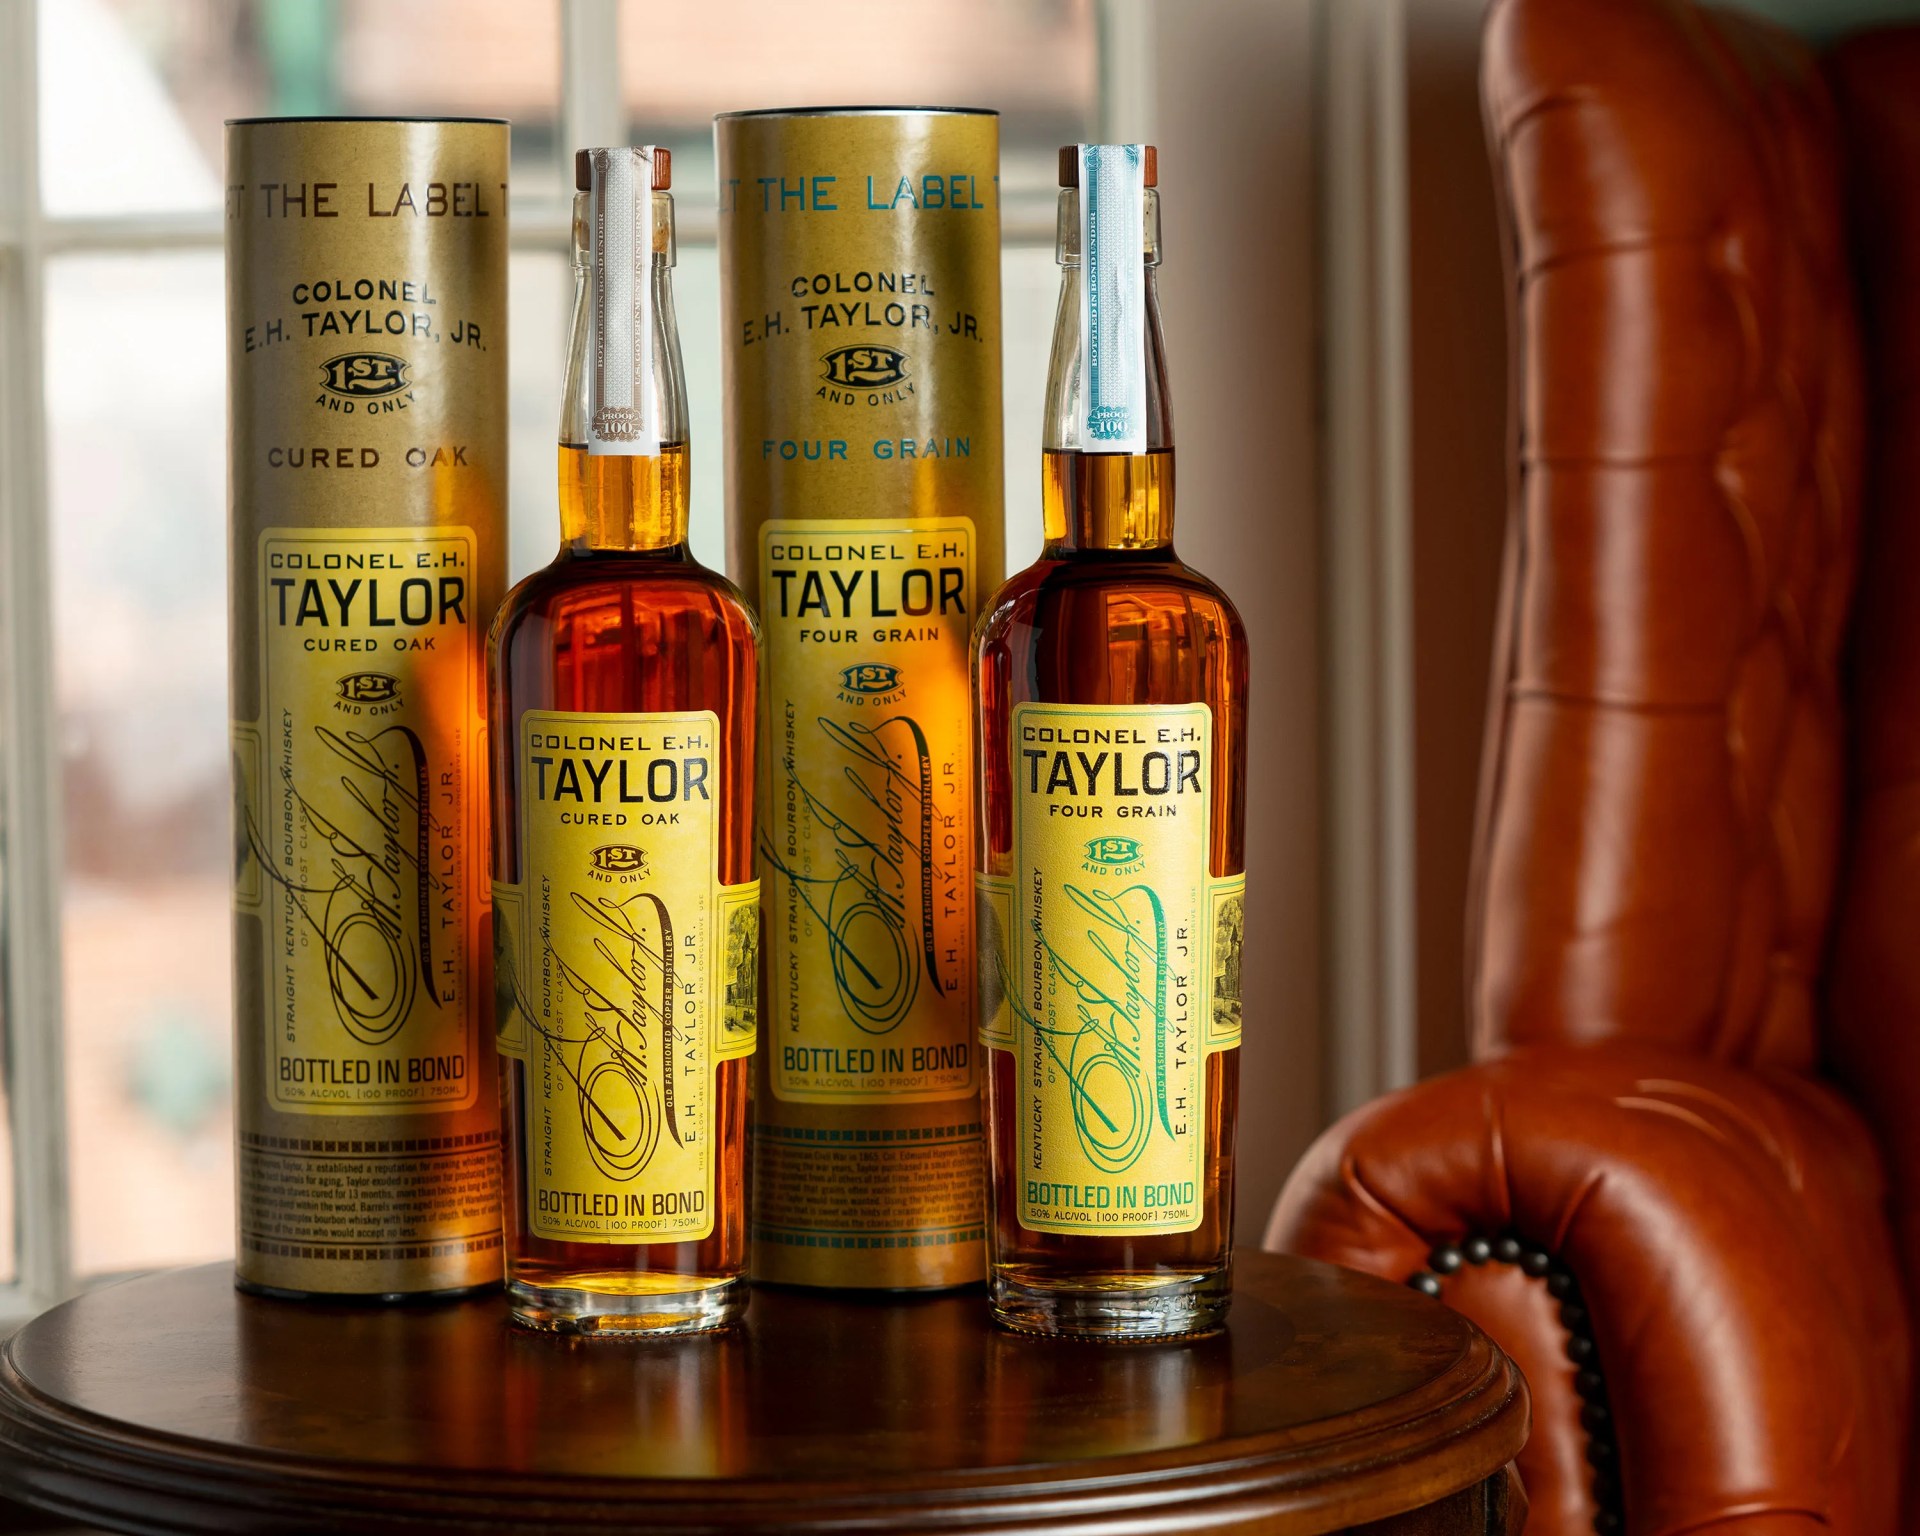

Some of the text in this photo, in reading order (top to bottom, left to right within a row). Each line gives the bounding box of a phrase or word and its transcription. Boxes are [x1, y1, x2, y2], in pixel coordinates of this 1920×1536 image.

[261, 183, 338, 218] THE
[368, 182, 490, 217] LABEL
[758, 176, 838, 212] THE
[868, 175, 984, 210] LABEL
[597, 212, 605, 256] UNDER
[292, 279, 436, 305] COLONEL
[792, 271, 935, 298] COLONEL
[598, 296, 605, 308] IN
[1091, 294, 1098, 307] IN
[245, 310, 487, 352] E.H. TAYLOR, JR.
[743, 301, 983, 346] E.H. TAYLOR, JR.
[597, 310, 605, 368] BOTTLED
[315, 391, 415, 415] AND ONLY
[816, 382, 916, 406] AND ONLY
[602, 411, 634, 421] PROOF
[603, 421, 633, 434] 100
[1096, 410, 1129, 420] PROOF
[1099, 420, 1128, 433] 100
[268, 446, 467, 469] CURED OAK
[763, 437, 970, 460] FOUR GRAIN
[271, 552, 464, 569] COLONEL E.H.
[772, 543, 964, 560] COLONEL E.H.
[270, 576, 466, 626] TAYLOR
[771, 567, 966, 617] TAYLOR
[304, 637, 435, 651] CURED OAK
[801, 628, 939, 643] FOUR GRAIN
[334, 699, 404, 716] AND ONLY
[836, 689, 907, 707] AND ONLY
[284, 707, 293, 781] WHISKEY
[531, 734, 709, 750] COLONEL E.H.
[786, 699, 795, 770] WHISKEY
[1023, 726, 1201, 744] COLONEL E.H.
[531, 756, 709, 803] TAYLOR
[1023, 749, 1202, 796] TAYLOR
[561, 812, 679, 825] CURED OAK
[788, 779, 797, 857] BOURBON
[1050, 804, 1177, 818] FOUR GRAIN
[285, 788, 294, 867] BOURBON
[921, 755, 933, 952] OLD FASHIONED COPPER DISTILLERY
[440, 762, 456, 1002] E.H. TAYLOR JR.
[587, 869, 651, 883] AND ONLY
[943, 753, 958, 991] E.H. TAYLOR JR.
[1081, 861, 1146, 876] AND ONLY
[542, 873, 551, 940] WHISKEY
[664, 929, 673, 983] DISTILLERY
[286, 965, 296, 1043] STRAIGHT
[790, 952, 800, 1032] KENTUCKY
[665, 988, 673, 1026] COPPER
[1034, 868, 1042, 1169] KENTUCKY STRAIGHT BOURBON WHISKEY
[1157, 921, 1166, 1099] OLD FASHIONED COPPER DISTILLERY
[684, 926, 696, 1142] E.H. TAYLOR JR.
[1175, 919, 1188, 1135] E.H. TAYLOR JR.
[281, 1055, 464, 1084] BOTTLED IN BOND
[544, 1025, 552, 1099] KENTUCKY
[784, 1043, 967, 1073] BOTTLED IN BOND
[311, 1089, 351, 1099] ALC/VOL
[556, 1074, 564, 1090] OF
[665, 1090, 673, 1107] OLD
[544, 1105, 552, 1177] STRAIGHT
[539, 1189, 704, 1216] BOTTLED IN BOND
[1027, 1181, 1194, 1209] BOTTLED IN BOND
[543, 1216, 561, 1226] 50%
[565, 1217, 601, 1229] ALC/VOL
[673, 1217, 701, 1227] 750ML
[1031, 1209, 1050, 1219] 50%
[1054, 1210, 1092, 1222] ALC/VOL
[1163, 1209, 1190, 1219] 750ML
